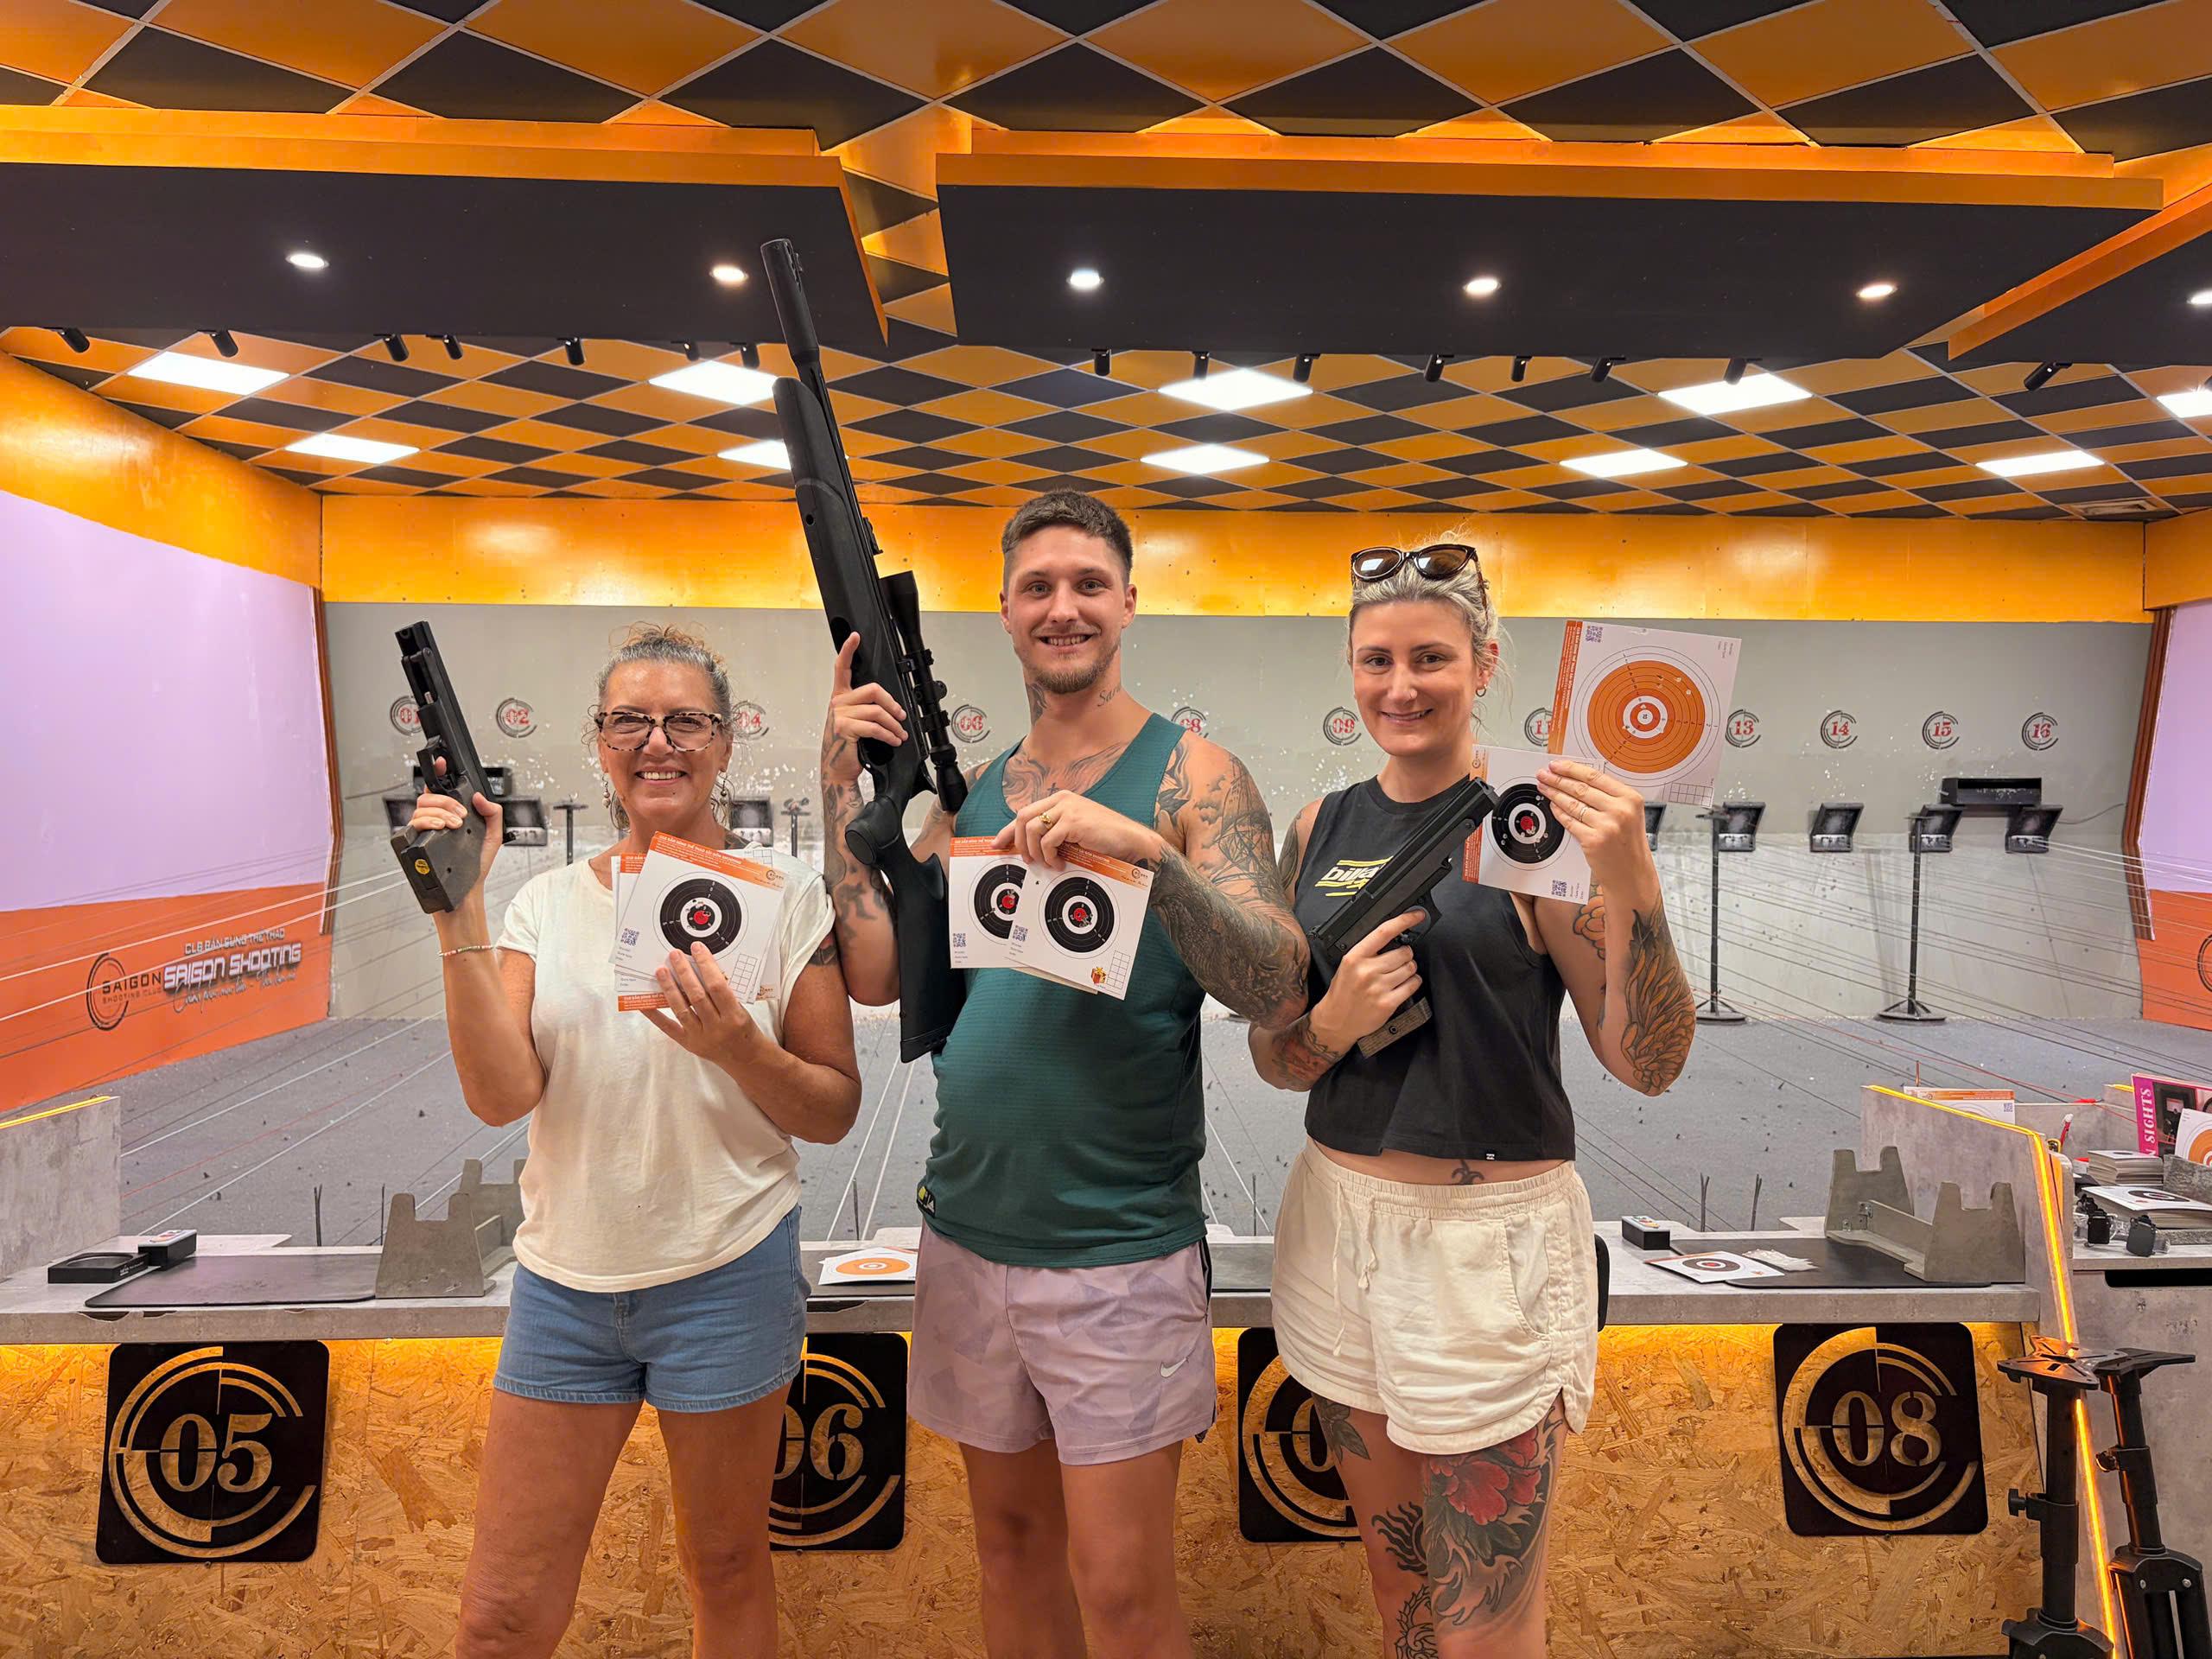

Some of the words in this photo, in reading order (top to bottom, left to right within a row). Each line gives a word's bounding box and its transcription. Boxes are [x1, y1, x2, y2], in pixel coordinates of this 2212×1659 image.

[505, 709, 530, 725] 02
[1333, 718, 1355, 734] 09
[1734, 720, 1754, 735] 13
[1830, 721, 1850, 736] 14
[1932, 721, 1952, 737] 15
[2031, 722, 2051, 739] 16
[1320, 863, 1386, 882] billa
[164, 956, 225, 989] SAIGON
[229, 943, 302, 976] SHOOTING
[103, 972, 162, 994] SAIGON
[2140, 1088, 2156, 1144] SIGHTS
[1292, 1397, 1336, 1472] 0
[1832, 1390, 1942, 1466] 08
[160, 1413, 272, 1493] 05
